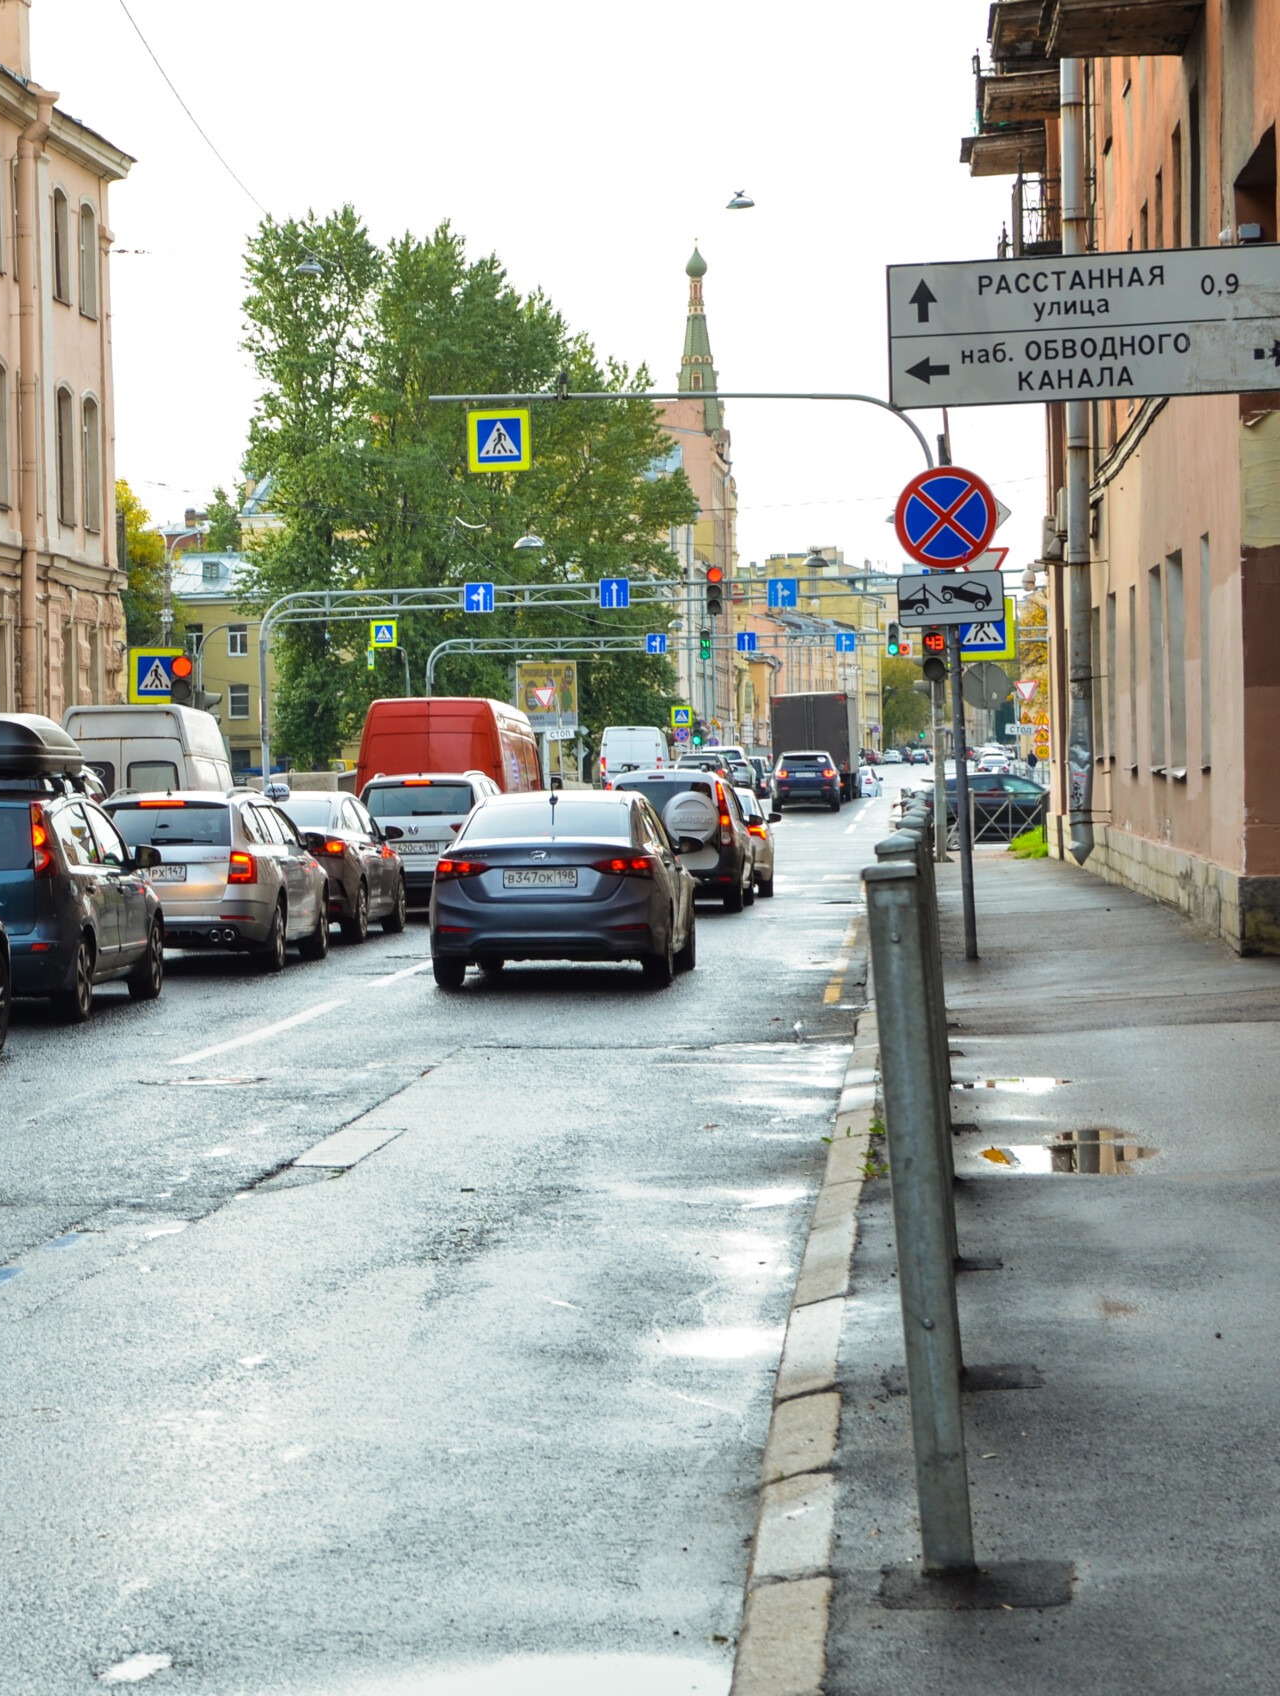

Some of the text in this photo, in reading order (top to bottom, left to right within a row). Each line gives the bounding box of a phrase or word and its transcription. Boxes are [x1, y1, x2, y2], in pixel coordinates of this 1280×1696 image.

[978, 265, 1240, 298] РАССТАННАЯ 0,9
[1033, 298, 1110, 323] улица
[961, 332, 1191, 365] наб. ОБВОДНОГО
[1018, 366, 1134, 391] КАНАЛА
[925, 635, 944, 650] 43
[549, 730, 571, 738] СТОП
[507, 870, 573, 883] В347ОК 198
